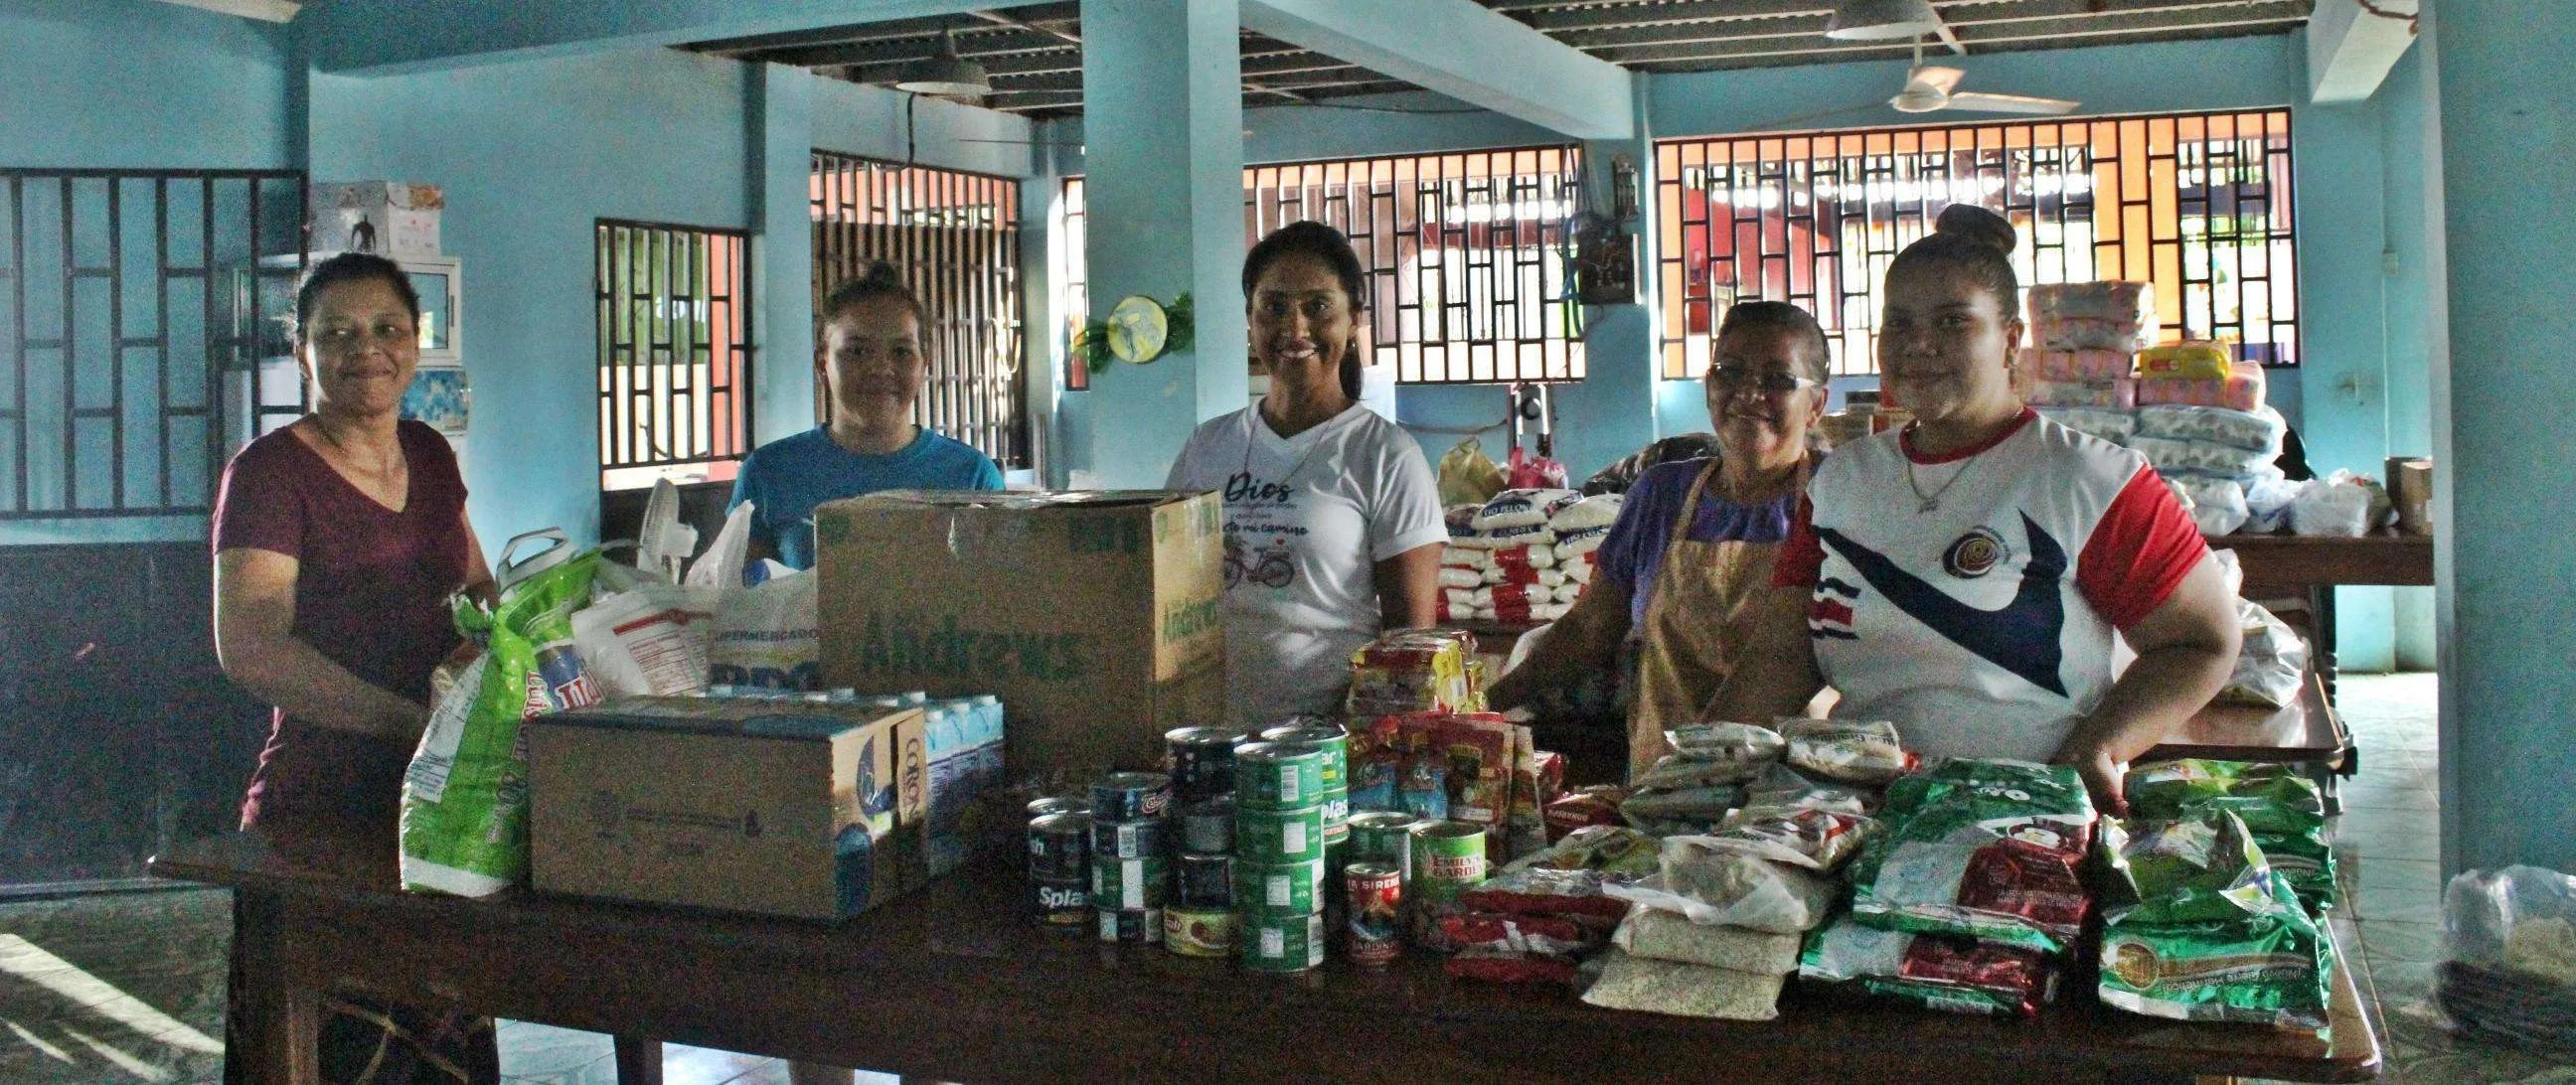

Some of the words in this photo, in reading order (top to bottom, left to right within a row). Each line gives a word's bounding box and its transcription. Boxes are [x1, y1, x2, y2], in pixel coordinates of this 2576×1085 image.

[1223, 472, 1295, 502] Dios
[1242, 523, 1259, 533] mi
[1261, 523, 1308, 536] camino
[863, 608, 1085, 682] Andrews
[1347, 879, 1359, 890] LA
